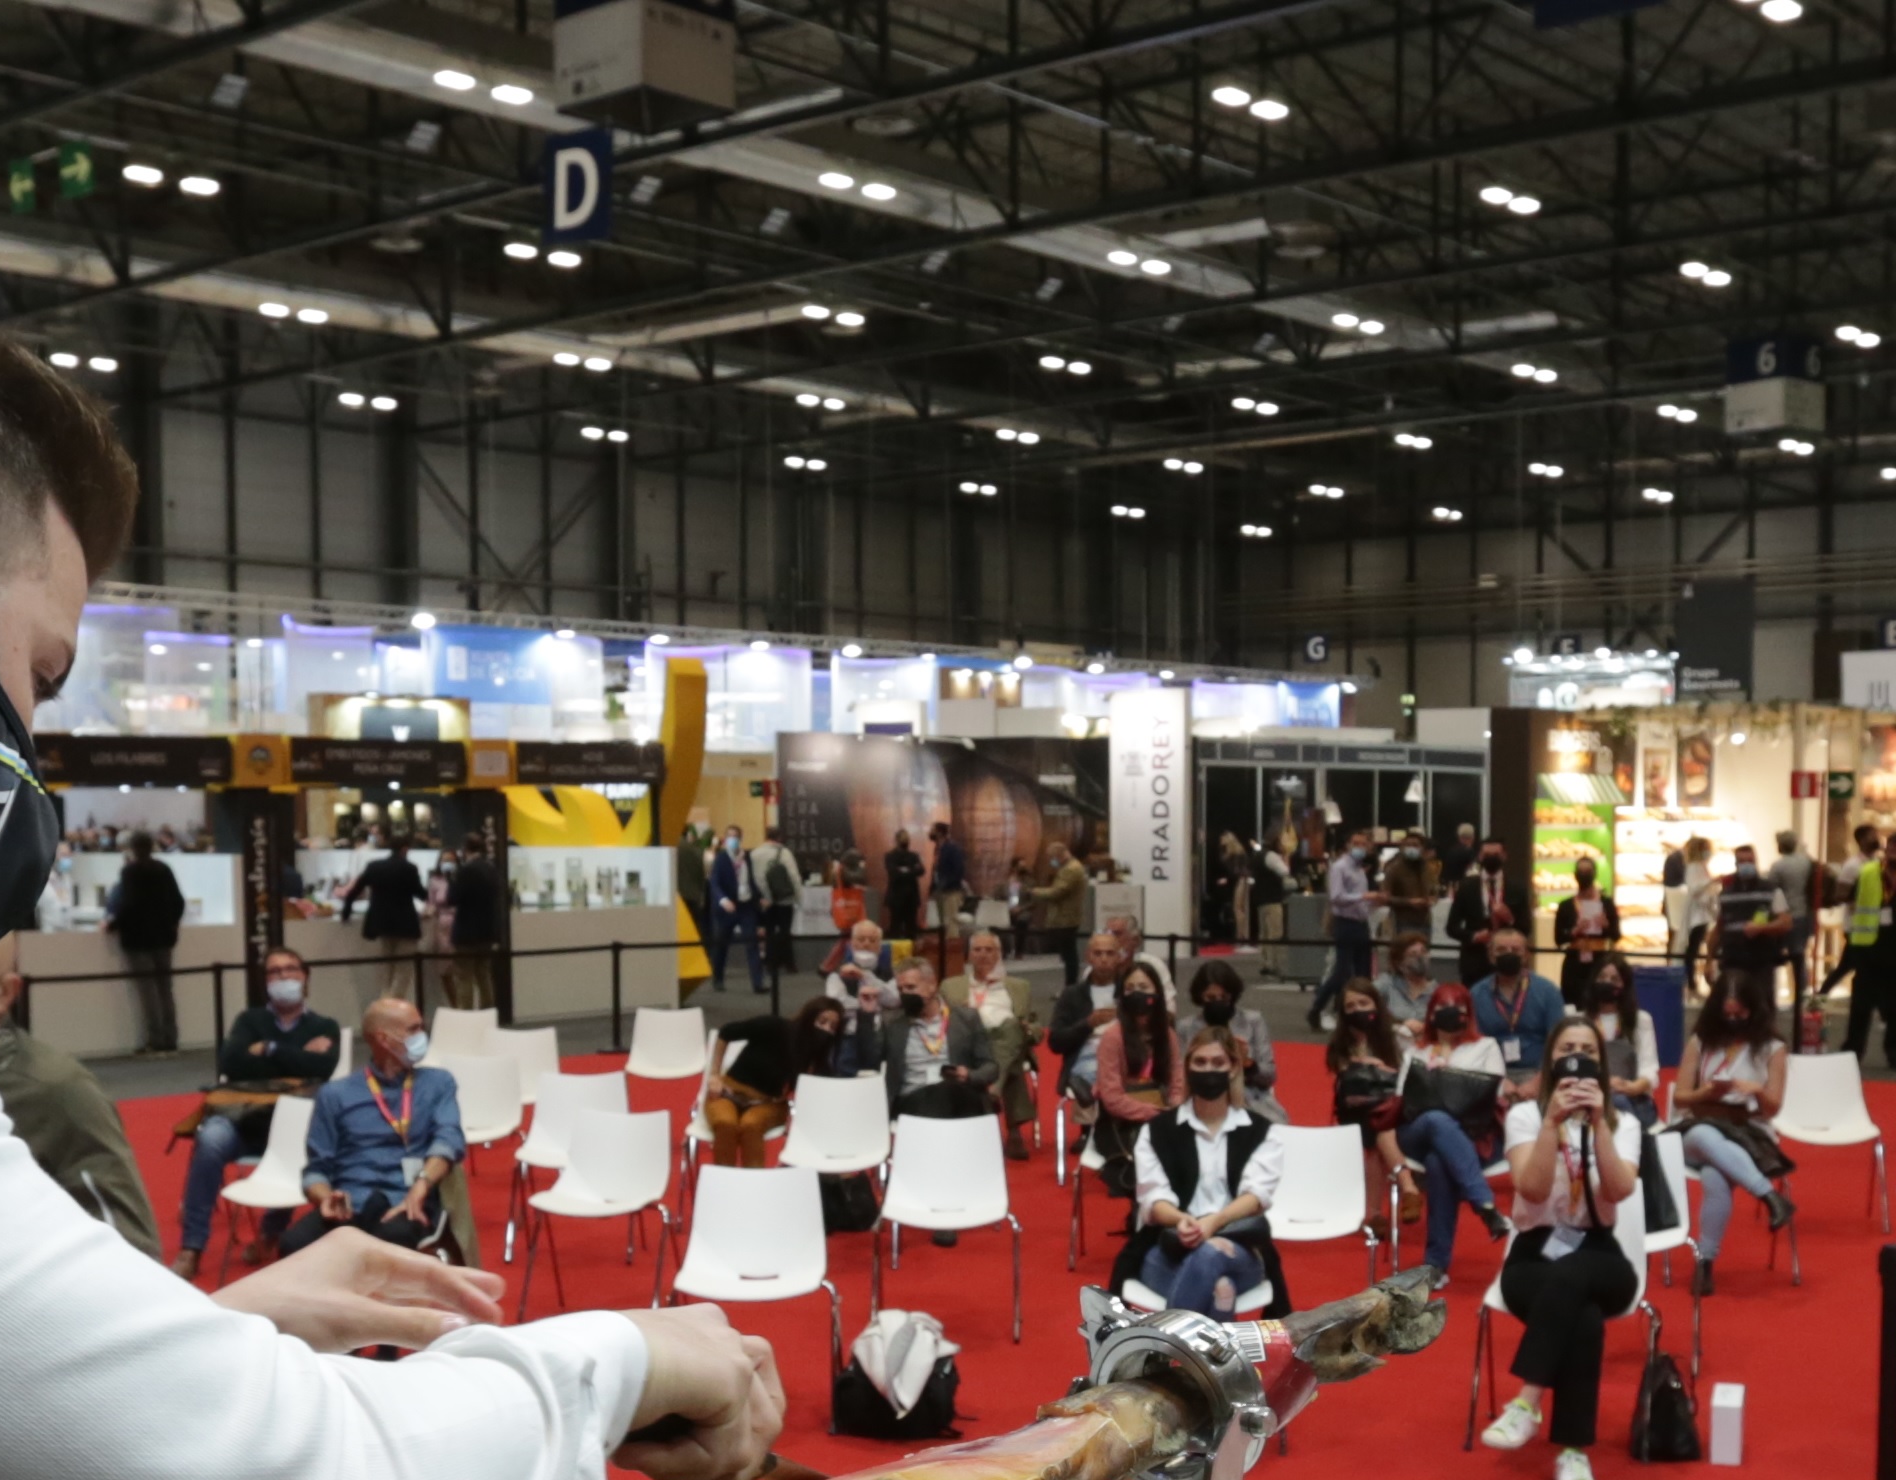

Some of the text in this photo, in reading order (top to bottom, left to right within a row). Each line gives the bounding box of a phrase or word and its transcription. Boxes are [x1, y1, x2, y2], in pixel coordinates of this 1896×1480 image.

[555, 147, 599, 230] D
[1756, 342, 1777, 375] 6
[1306, 636, 1325, 660] G
[1151, 715, 1171, 882] PRADOREY
